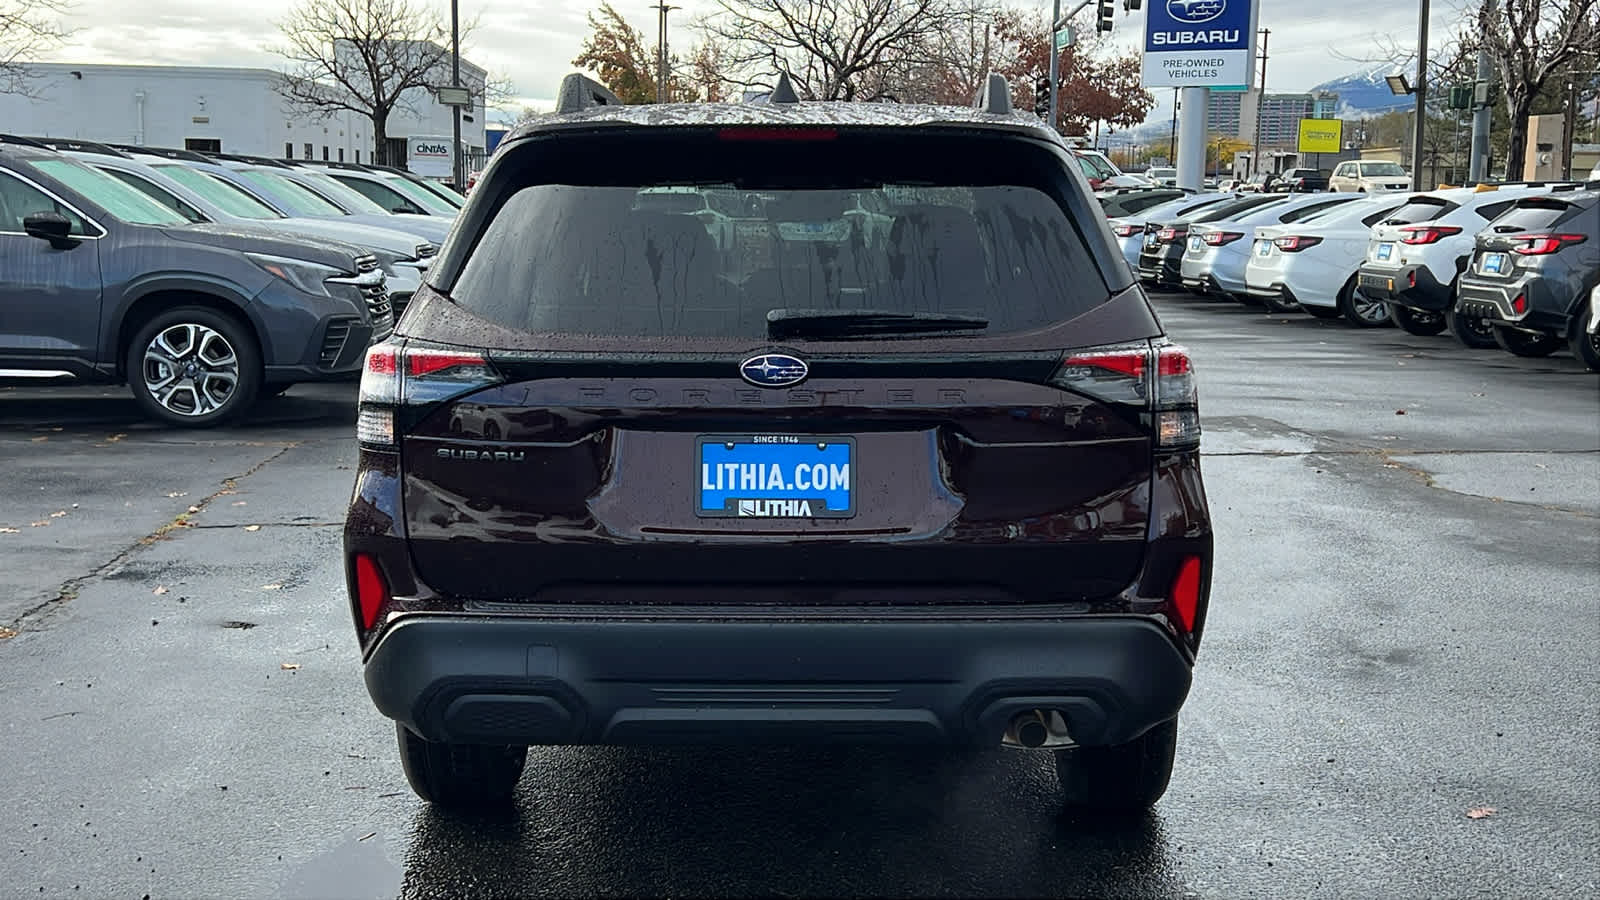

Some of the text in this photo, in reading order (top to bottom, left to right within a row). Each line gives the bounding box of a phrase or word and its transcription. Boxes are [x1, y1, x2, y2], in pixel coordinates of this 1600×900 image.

[1152, 29, 1240, 45] SUBARU
[1163, 58, 1225, 69] PRE-OWNED
[1168, 69, 1218, 78] VEHICLES
[578, 386, 967, 406] FORESTER
[753, 435, 799, 444] SINCE 1946
[436, 448, 525, 462] SUBARU
[702, 463, 850, 491] LITHIA.COM
[755, 499, 812, 517] LITHIA
